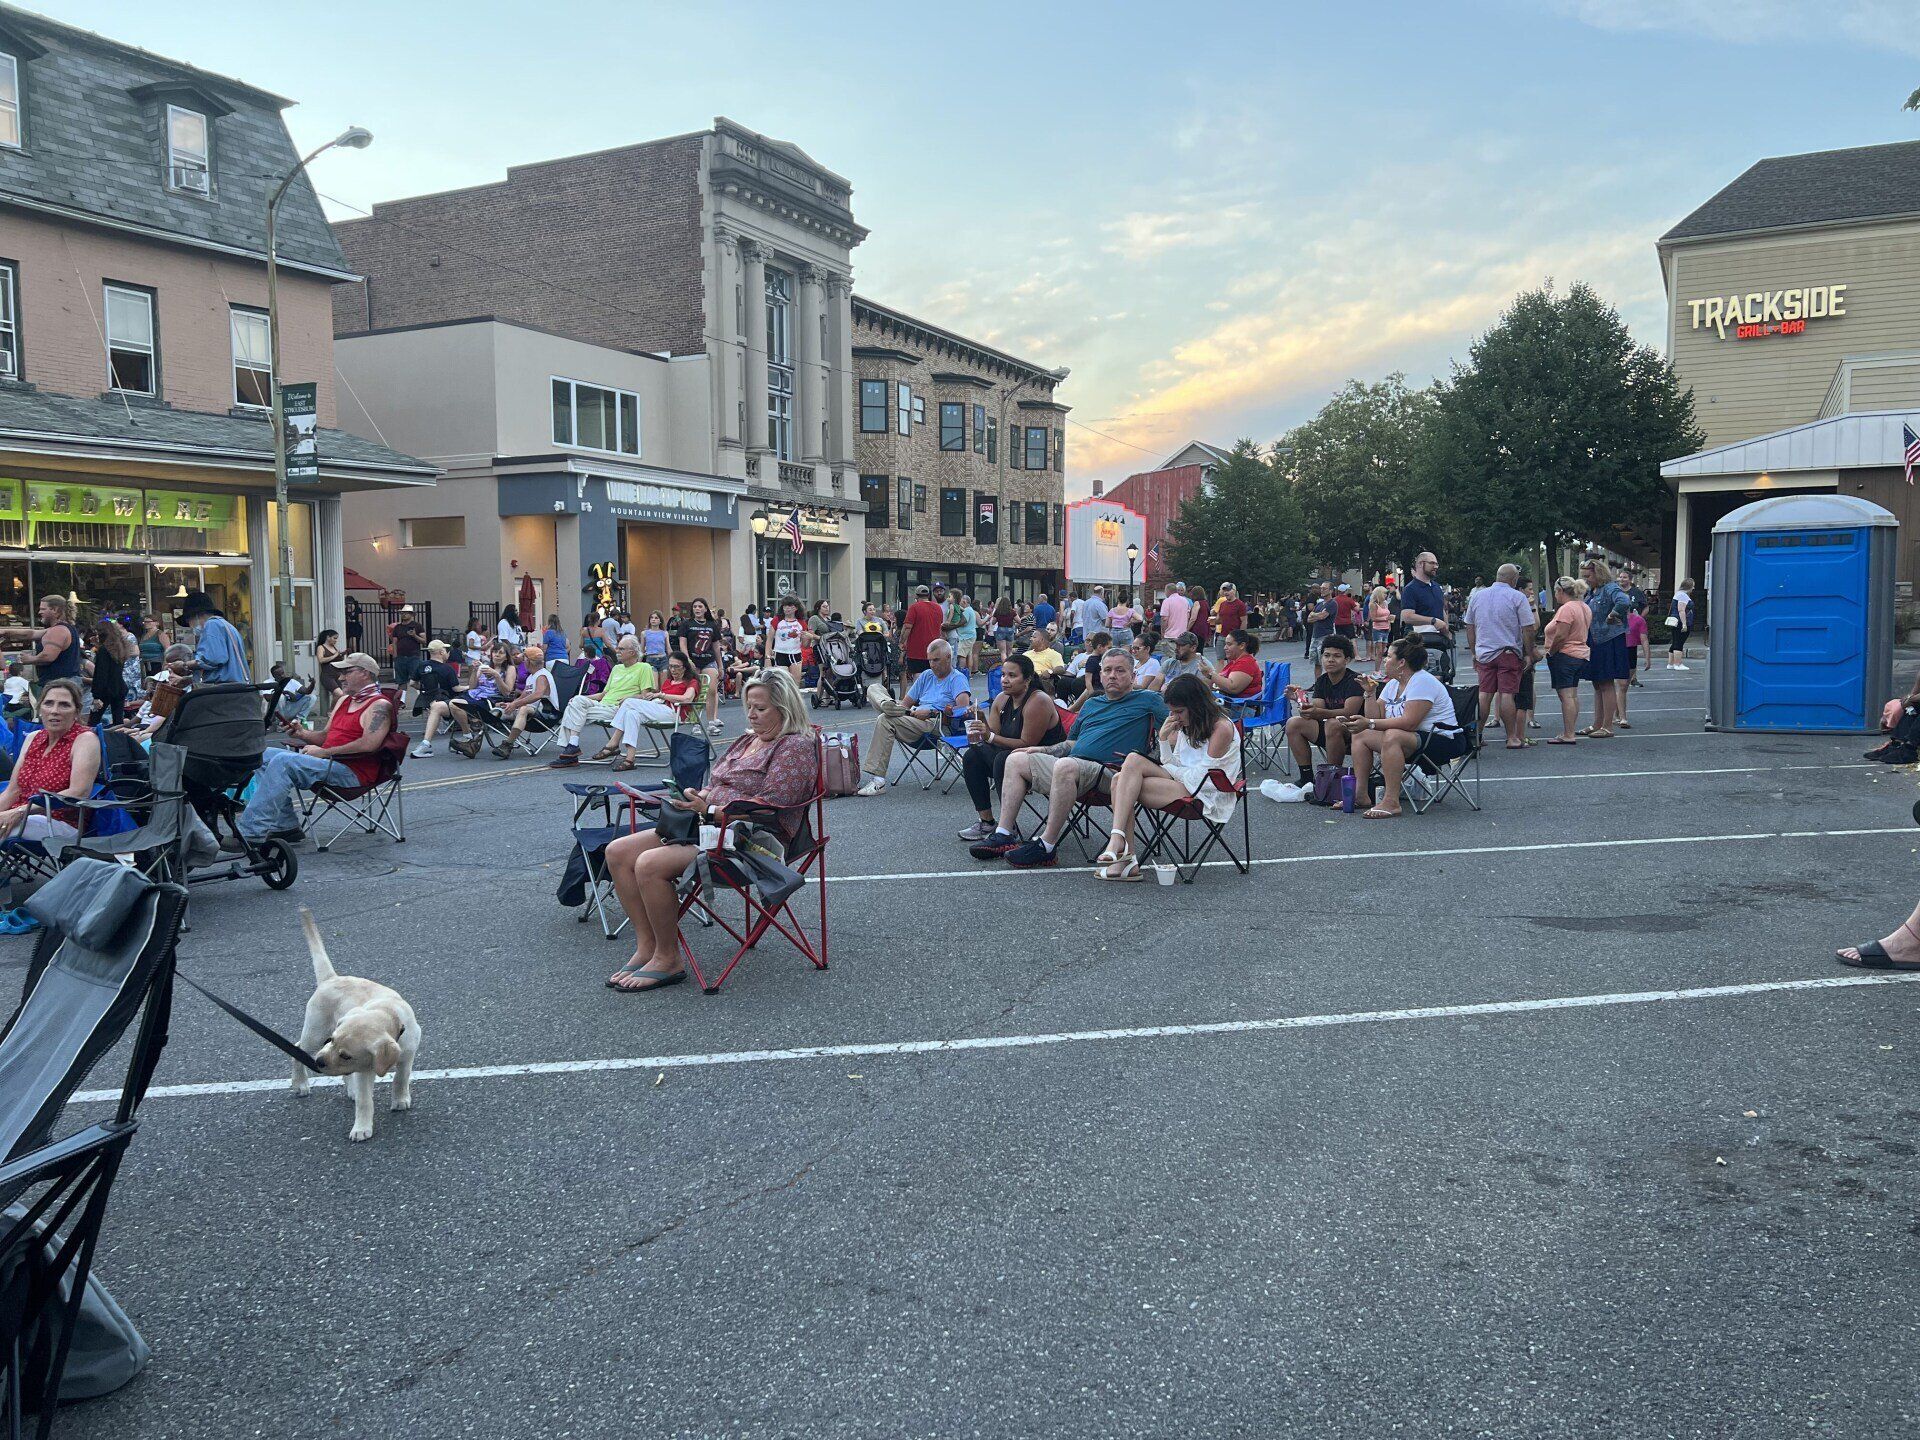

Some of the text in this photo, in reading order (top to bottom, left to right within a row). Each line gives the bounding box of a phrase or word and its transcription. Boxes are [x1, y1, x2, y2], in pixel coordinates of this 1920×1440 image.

[1687, 284, 1848, 340] TRACKSIDE
[1737, 320, 1806, 339] GRILL BAR
[0, 489, 212, 521] HARDWARE
[611, 507, 708, 523] MOUNTAIN VIEW VINEYARD
